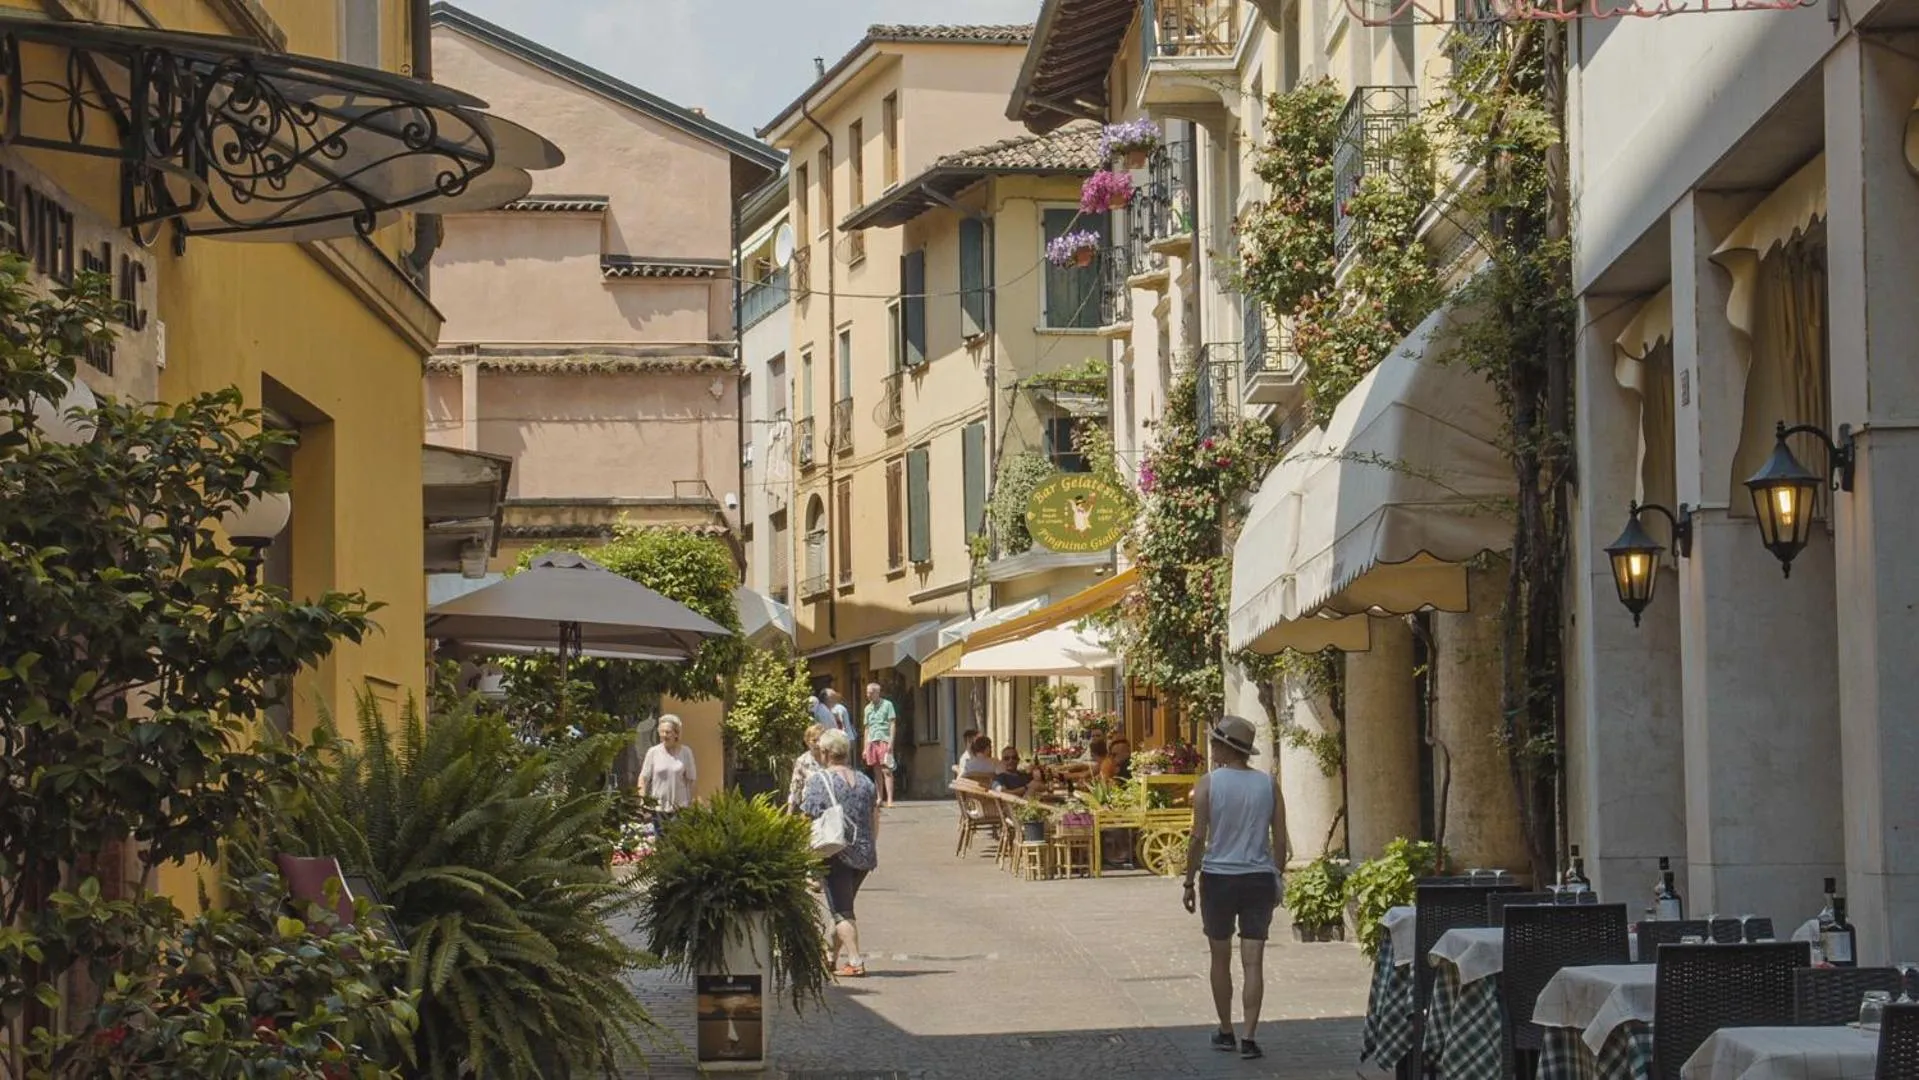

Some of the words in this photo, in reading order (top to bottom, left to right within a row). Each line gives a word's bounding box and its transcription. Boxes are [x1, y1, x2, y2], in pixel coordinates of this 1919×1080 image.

[1033, 482, 1057, 505] Bar
[1037, 527, 1087, 551] Pinguino
[1090, 526, 1121, 550] Giallo
